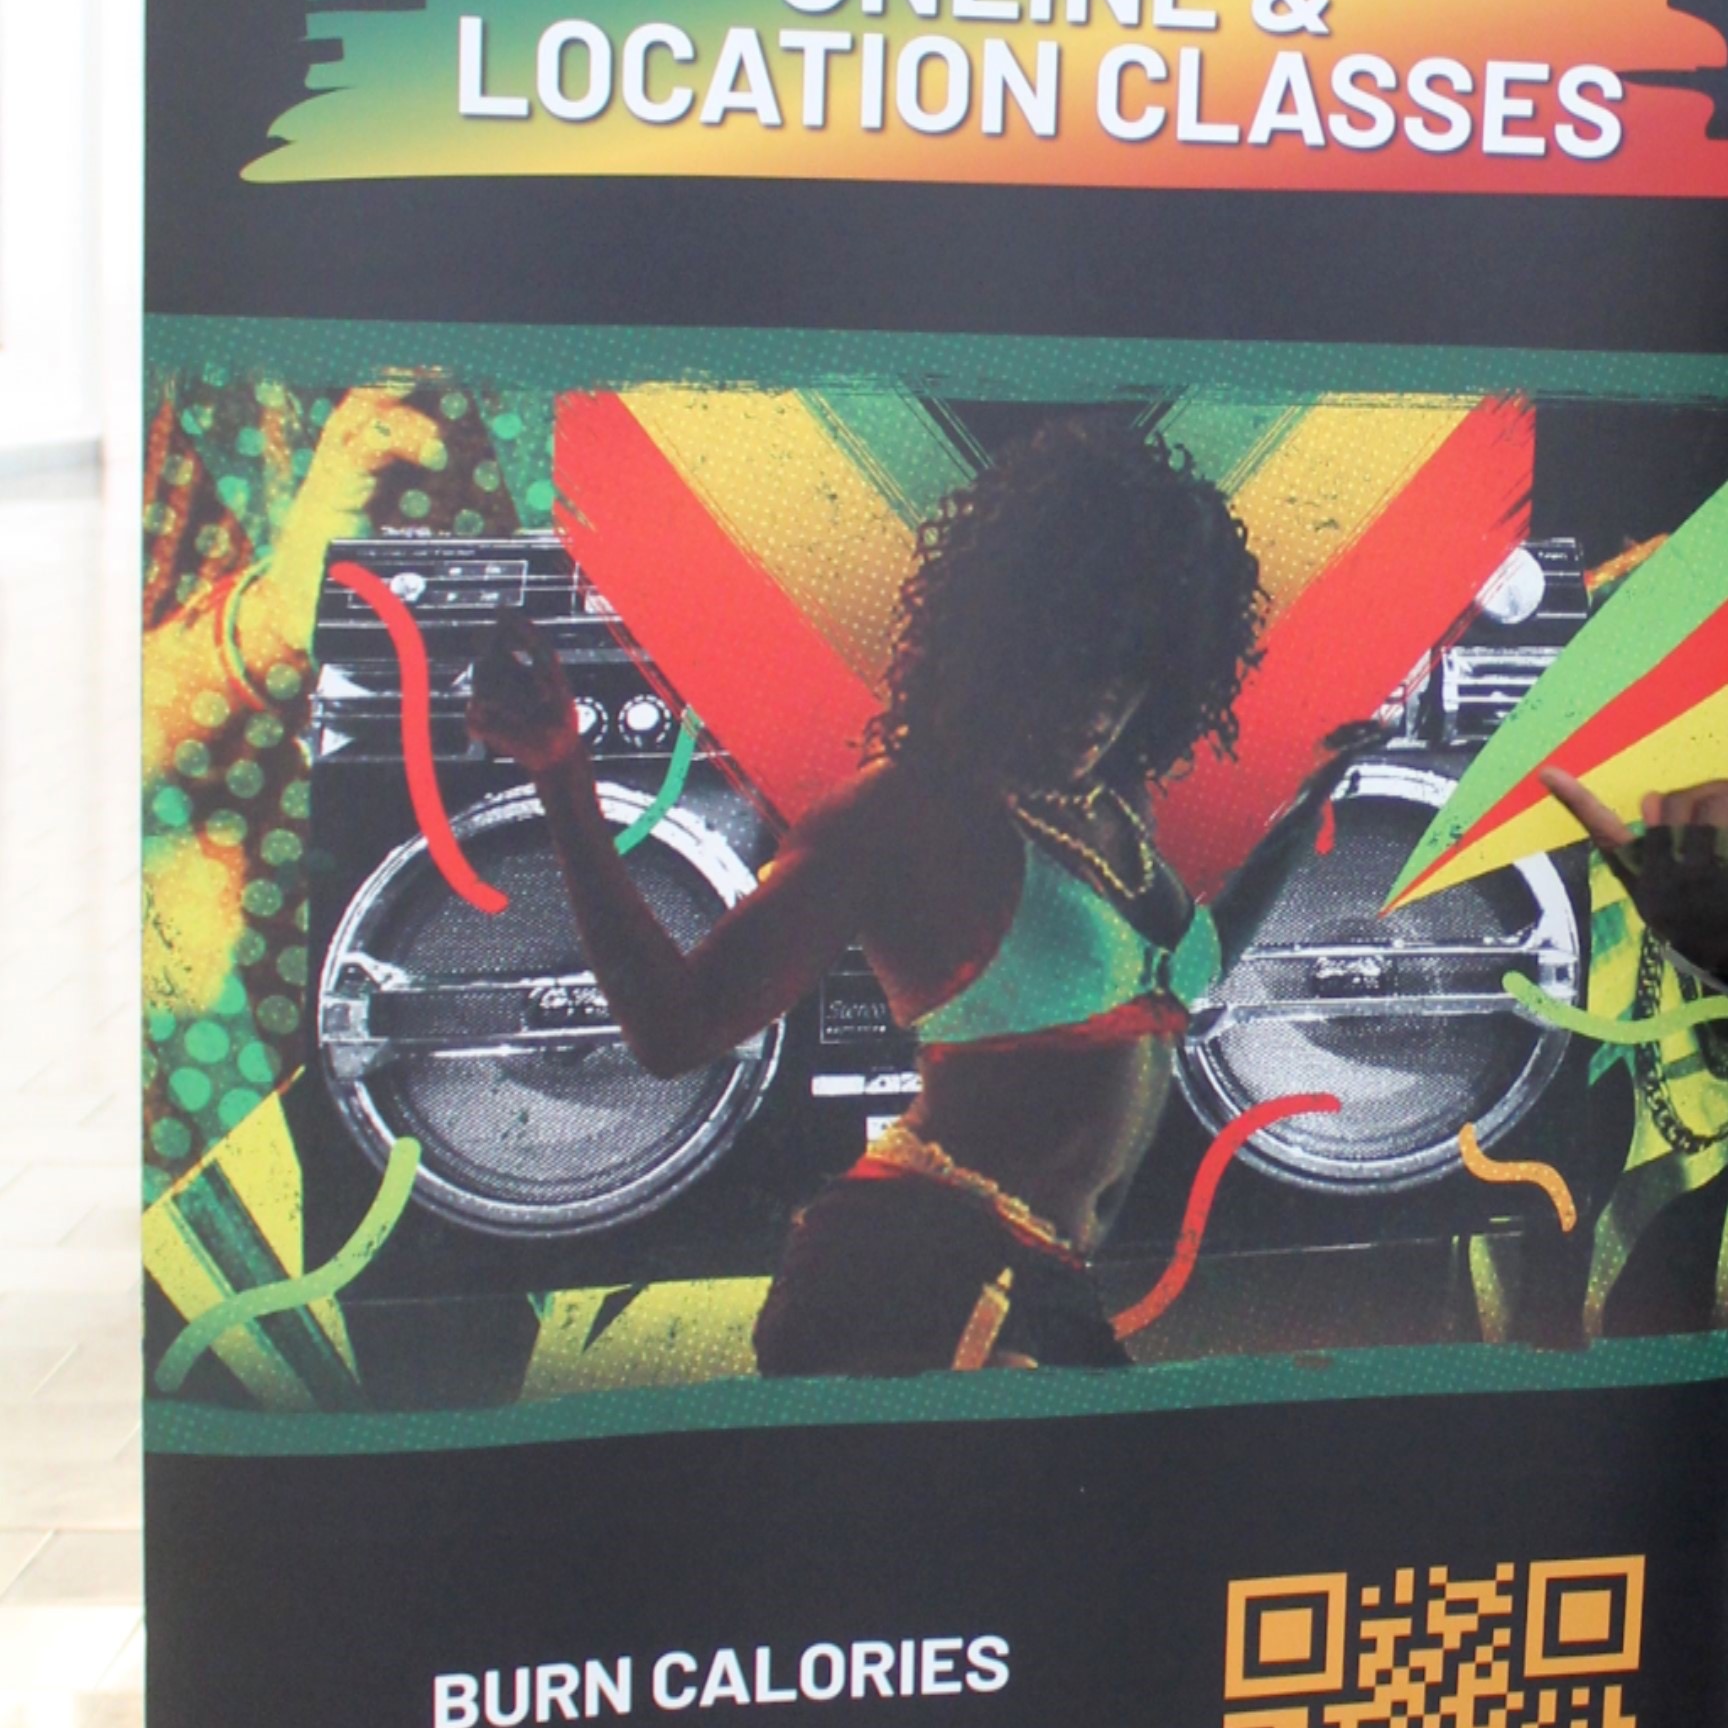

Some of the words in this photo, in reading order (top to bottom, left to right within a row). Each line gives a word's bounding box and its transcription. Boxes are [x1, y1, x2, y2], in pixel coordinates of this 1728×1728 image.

[457, 15, 1061, 136] LOCATION
[1096, 44, 1625, 160] CLASSES
[651, 1633, 1012, 1712] CALORIES
